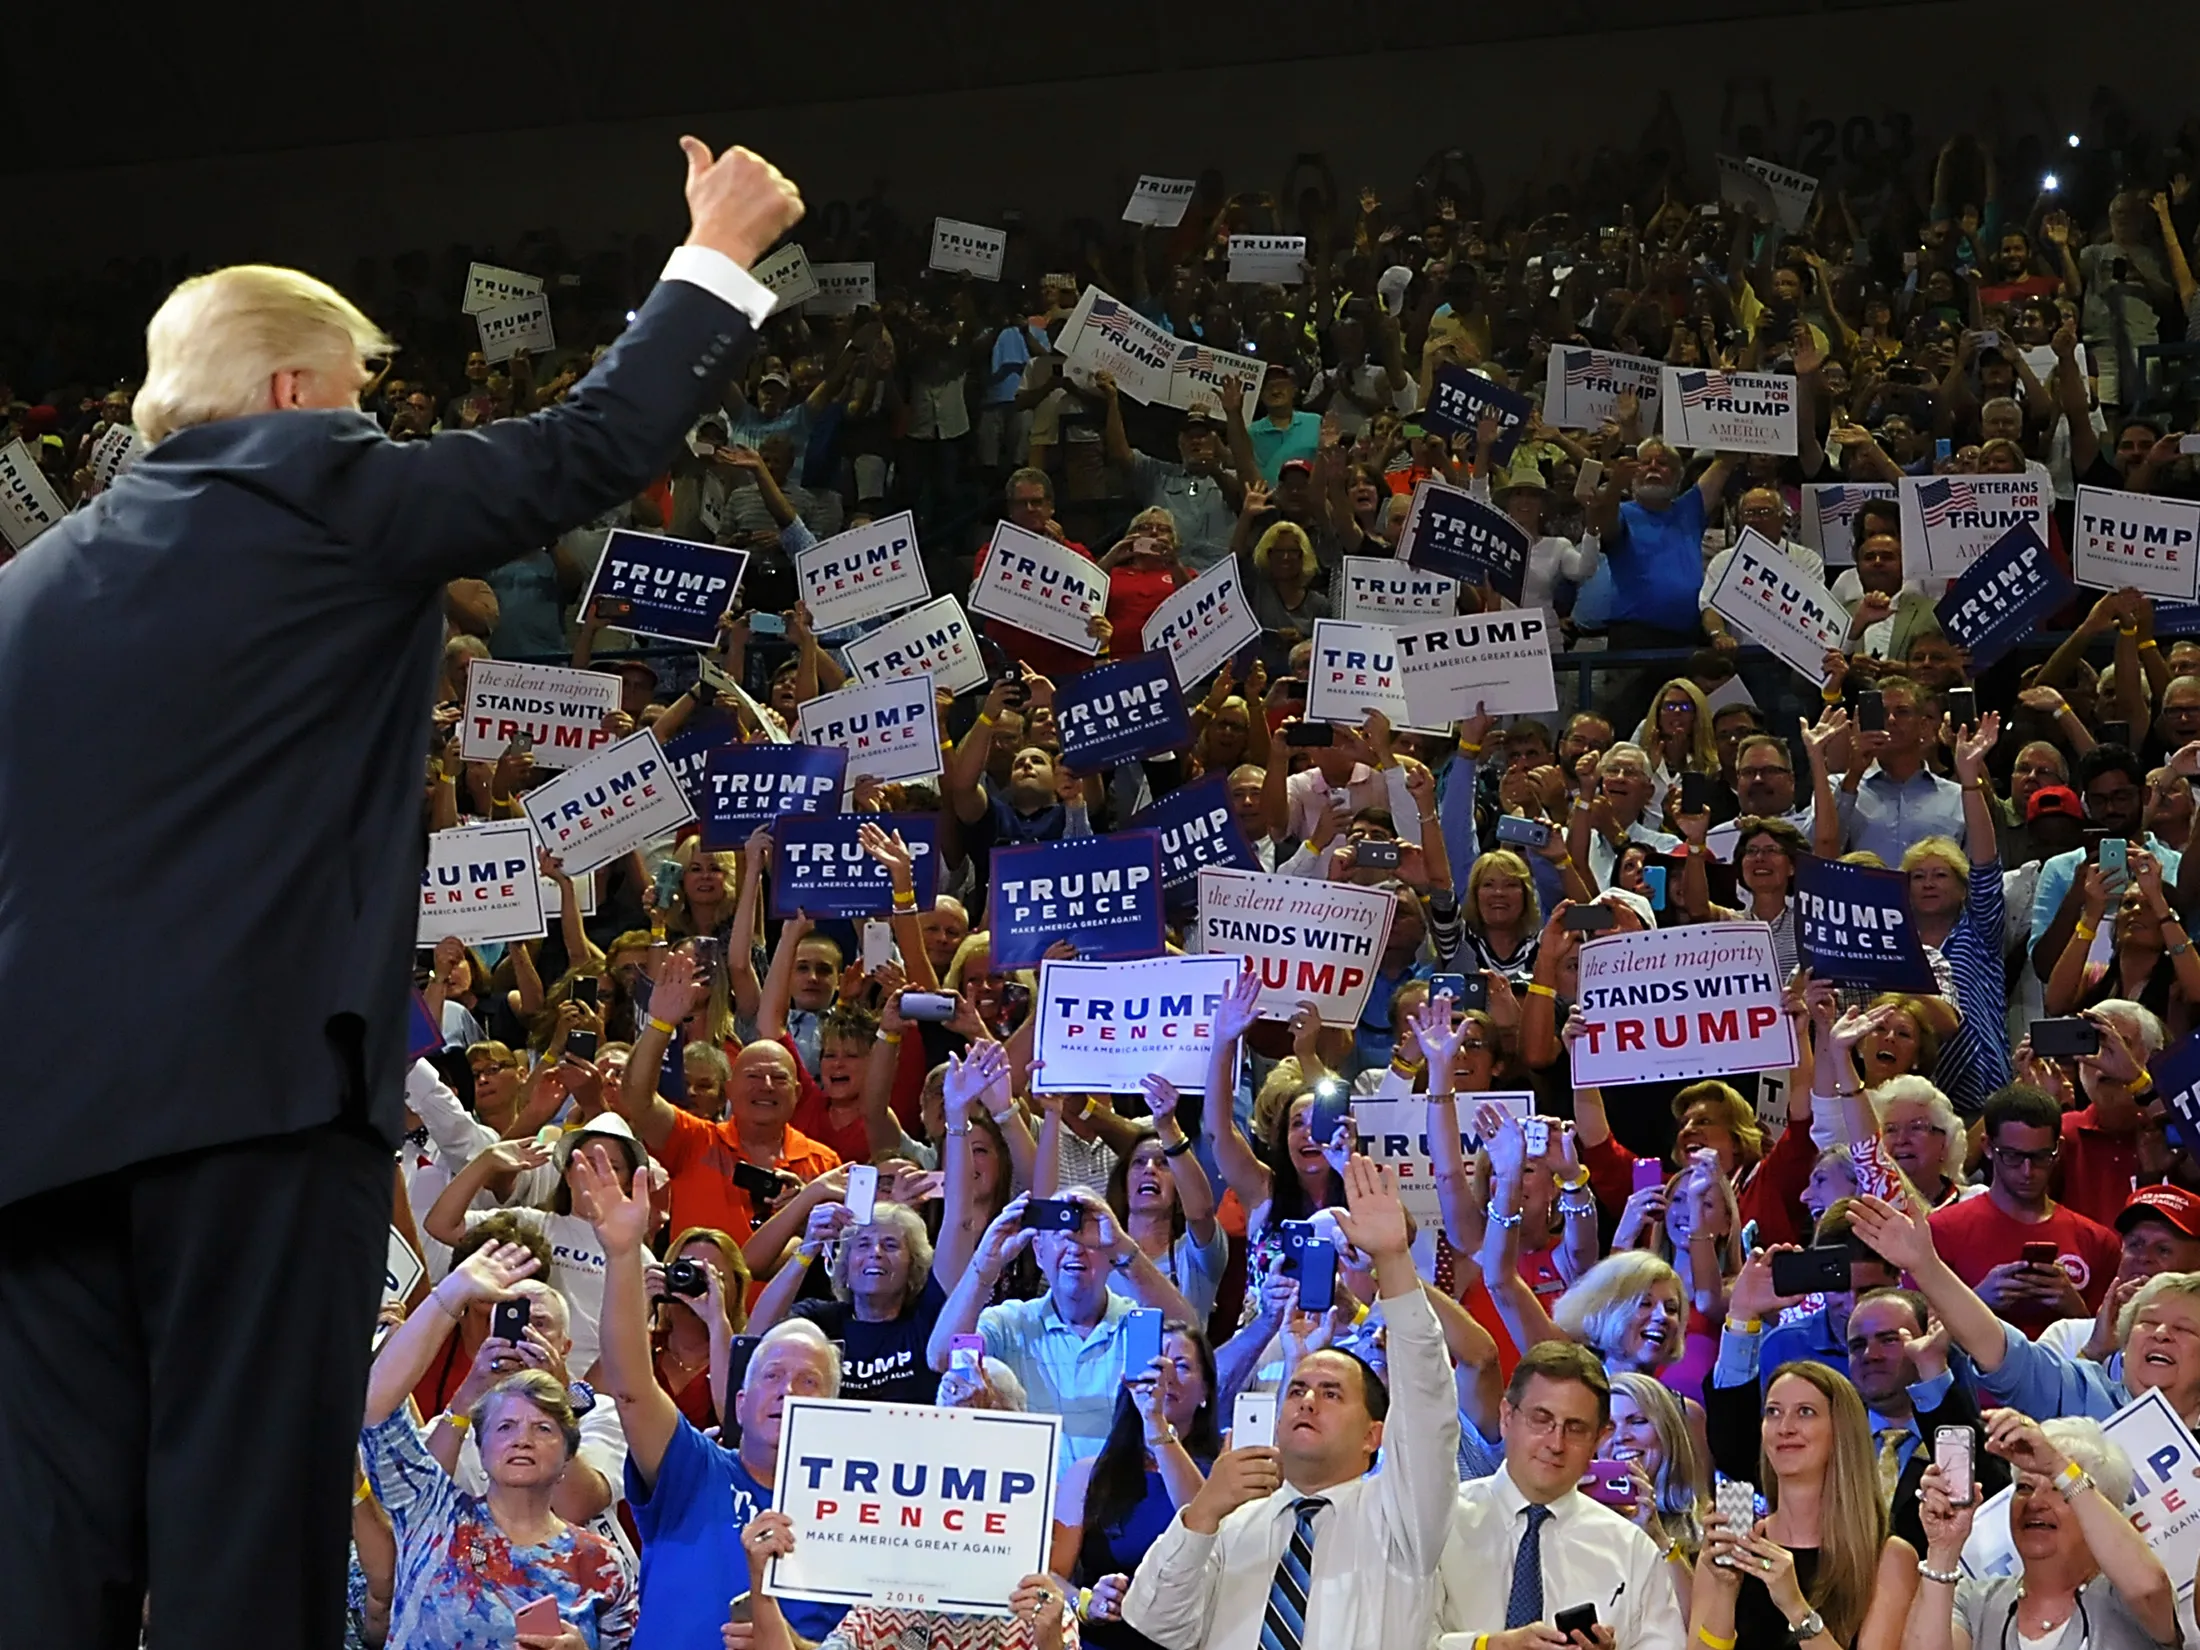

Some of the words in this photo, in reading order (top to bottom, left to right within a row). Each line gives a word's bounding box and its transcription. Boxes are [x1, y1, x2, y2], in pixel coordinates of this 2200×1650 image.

[1139, 180, 1194, 196] TRUMP
[940, 232, 999, 253] TRUMP
[943, 244, 993, 260] PENCE
[1230, 240, 1304, 250] TRUMP
[762, 260, 800, 285] UMP
[818, 277, 870, 287] RUMP
[483, 310, 543, 334] TRUMP
[490, 323, 538, 341] PENCE
[1129, 317, 1176, 352] VETERANS
[1100, 324, 1166, 370] TRUMP
[1151, 344, 1171, 358] FOR
[1211, 354, 1259, 373] VETERANS
[1238, 370, 1258, 380] FOR
[1608, 358, 1660, 375] VETERANS
[1188, 367, 1256, 393] TRUP
[1726, 377, 1788, 390] VETERANS
[1440, 382, 1519, 426] TRUP
[1701, 397, 1790, 416] TRUMP
[1764, 390, 1788, 401] FOR
[1708, 423, 1781, 441] AMERICA
[1969, 481, 2039, 494] VETERANS
[2011, 495, 2038, 507] FOR
[1431, 512, 1521, 562] TRUMP
[2083, 514, 2192, 547] TRUMP
[806, 538, 908, 585] TRUMP
[1435, 531, 1512, 571] PENCE
[2089, 538, 2178, 562] PENCE
[2102, 556, 2128, 566] AMERICA
[2130, 560, 2152, 569] GREAT
[611, 560, 726, 593] TRUMP
[816, 560, 902, 597] PENCE
[999, 549, 1101, 601] TRUMP
[1351, 577, 1451, 595] TRUMP
[613, 580, 709, 606] PENCE
[1001, 571, 1091, 613] PENCE
[1359, 594, 1441, 607] PENCE
[1742, 553, 1840, 636] TRUMP
[1949, 546, 2038, 632] TRUMP
[659, 602, 681, 611] GREAT
[1742, 575, 1829, 641] PENCE
[1962, 569, 2041, 640] PENCE
[1983, 612, 2010, 637] AMERICA
[2010, 596, 2030, 616] GREAT
[1173, 602, 1229, 652] ENCE
[1397, 620, 1542, 657] TRUMP
[864, 621, 962, 679] TRUMP
[901, 643, 962, 677] ENCE
[1323, 649, 1394, 672] TRU
[1402, 662, 1430, 674] MAKE
[1432, 656, 1477, 671] AMERICA
[1480, 651, 1511, 662] GREAT
[1513, 648, 1548, 659] AGAIN!
[478, 671, 501, 686] the
[504, 674, 545, 692] silent
[549, 680, 614, 703] majority
[1332, 672, 1391, 688] PEN
[476, 693, 554, 715] STANDS
[1057, 678, 1169, 730] TRUMP
[1350, 690, 1383, 698] AMERICA
[473, 717, 609, 750] TRUMP
[811, 703, 925, 746] TRUMP
[1064, 702, 1163, 742] PENCE
[1064, 743, 1083, 753] MAKE
[1084, 733, 1117, 747] AMERICA
[1119, 724, 1142, 736] GREAT
[868, 748, 891, 757] GREAT
[541, 759, 657, 831] TRUMP
[712, 773, 834, 796] TRUMP
[558, 784, 657, 841] PENCE
[718, 796, 817, 813] PENCE
[562, 839, 582, 852] MAKE
[583, 822, 614, 843] AMERICA
[615, 809, 639, 825] GREAT
[1161, 808, 1228, 854] UMP
[785, 842, 929, 862] TRUP
[420, 859, 526, 887] RUMP
[796, 865, 914, 878] PENC
[1002, 866, 1150, 904] TRUMP
[424, 884, 514, 904] ENCE
[1208, 885, 1229, 907] the
[1234, 888, 1284, 912] silent
[1289, 897, 1378, 930] majority
[422, 908, 457, 916] AMERICA
[460, 905, 487, 914] GREAT
[491, 901, 520, 910] AGAIN!
[1015, 895, 1136, 922] PENCE
[1799, 890, 1904, 931] TRUMP
[1011, 926, 1035, 935] MAKE
[1037, 922, 1078, 932] AMERICA
[1080, 918, 1108, 928] GREAT
[1110, 914, 1142, 924] AGAIN!
[1208, 917, 1296, 946] STANDS
[1303, 928, 1372, 957] WITH
[1804, 921, 1897, 950] PENCE
[1584, 955, 1607, 978] the
[1611, 950, 1667, 974] silent
[1674, 941, 1764, 972] majority
[1815, 947, 1846, 958] AMERICA
[1847, 952, 1873, 960] GREAT
[1208, 950, 1364, 997] UMP
[1583, 980, 1690, 1011] STANDS
[1694, 973, 1772, 998] WITH
[1068, 1023, 1210, 1040] PENCE
[1584, 1006, 1778, 1054] TRUMP
[1061, 1044, 1089, 1052] MAKE
[1093, 1045, 1138, 1054] AMERICA
[1142, 1044, 1174, 1052] GREAT
[842, 1351, 912, 1379] RUMP
[800, 1456, 1035, 1504] TRUMP
[815, 1500, 1007, 1535] PENCE
[2164, 1510, 2200, 1540] AGAIN
[806, 1530, 844, 1543] MAKE
[849, 1534, 909, 1548] AMERICA
[914, 1538, 958, 1551] GREAT
[963, 1542, 1011, 1555] AGAIN!
[887, 1591, 925, 1604] 2016
